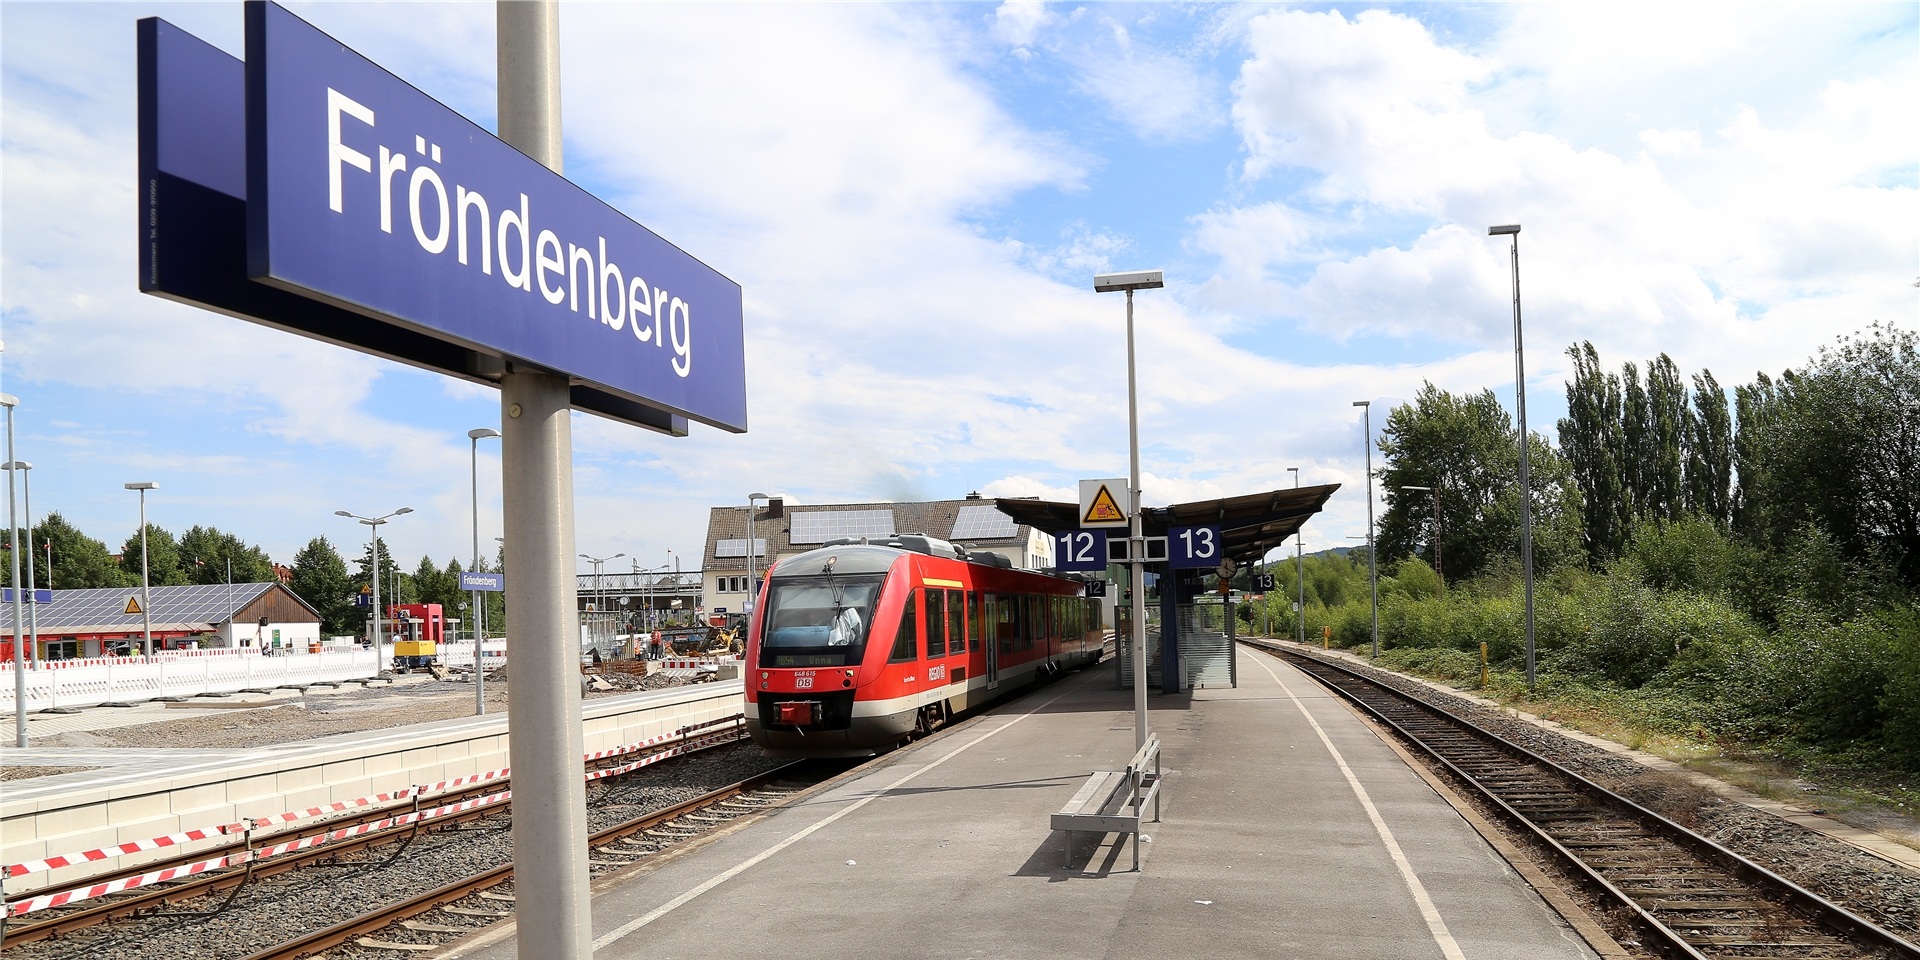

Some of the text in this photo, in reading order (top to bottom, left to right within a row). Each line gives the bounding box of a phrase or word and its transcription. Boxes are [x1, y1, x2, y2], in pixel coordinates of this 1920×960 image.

[327, 87, 691, 378] Fröndenberg
[1060, 532, 1095, 562] 12
[1179, 527, 1215, 559] 13
[463, 575, 497, 588] Fröndenberg
[1086, 581, 1101, 594] 12
[1257, 575, 1273, 588] 13
[356, 594, 362, 605] 1
[809, 655, 832, 665] Unna
[796, 678, 812, 688] DB
